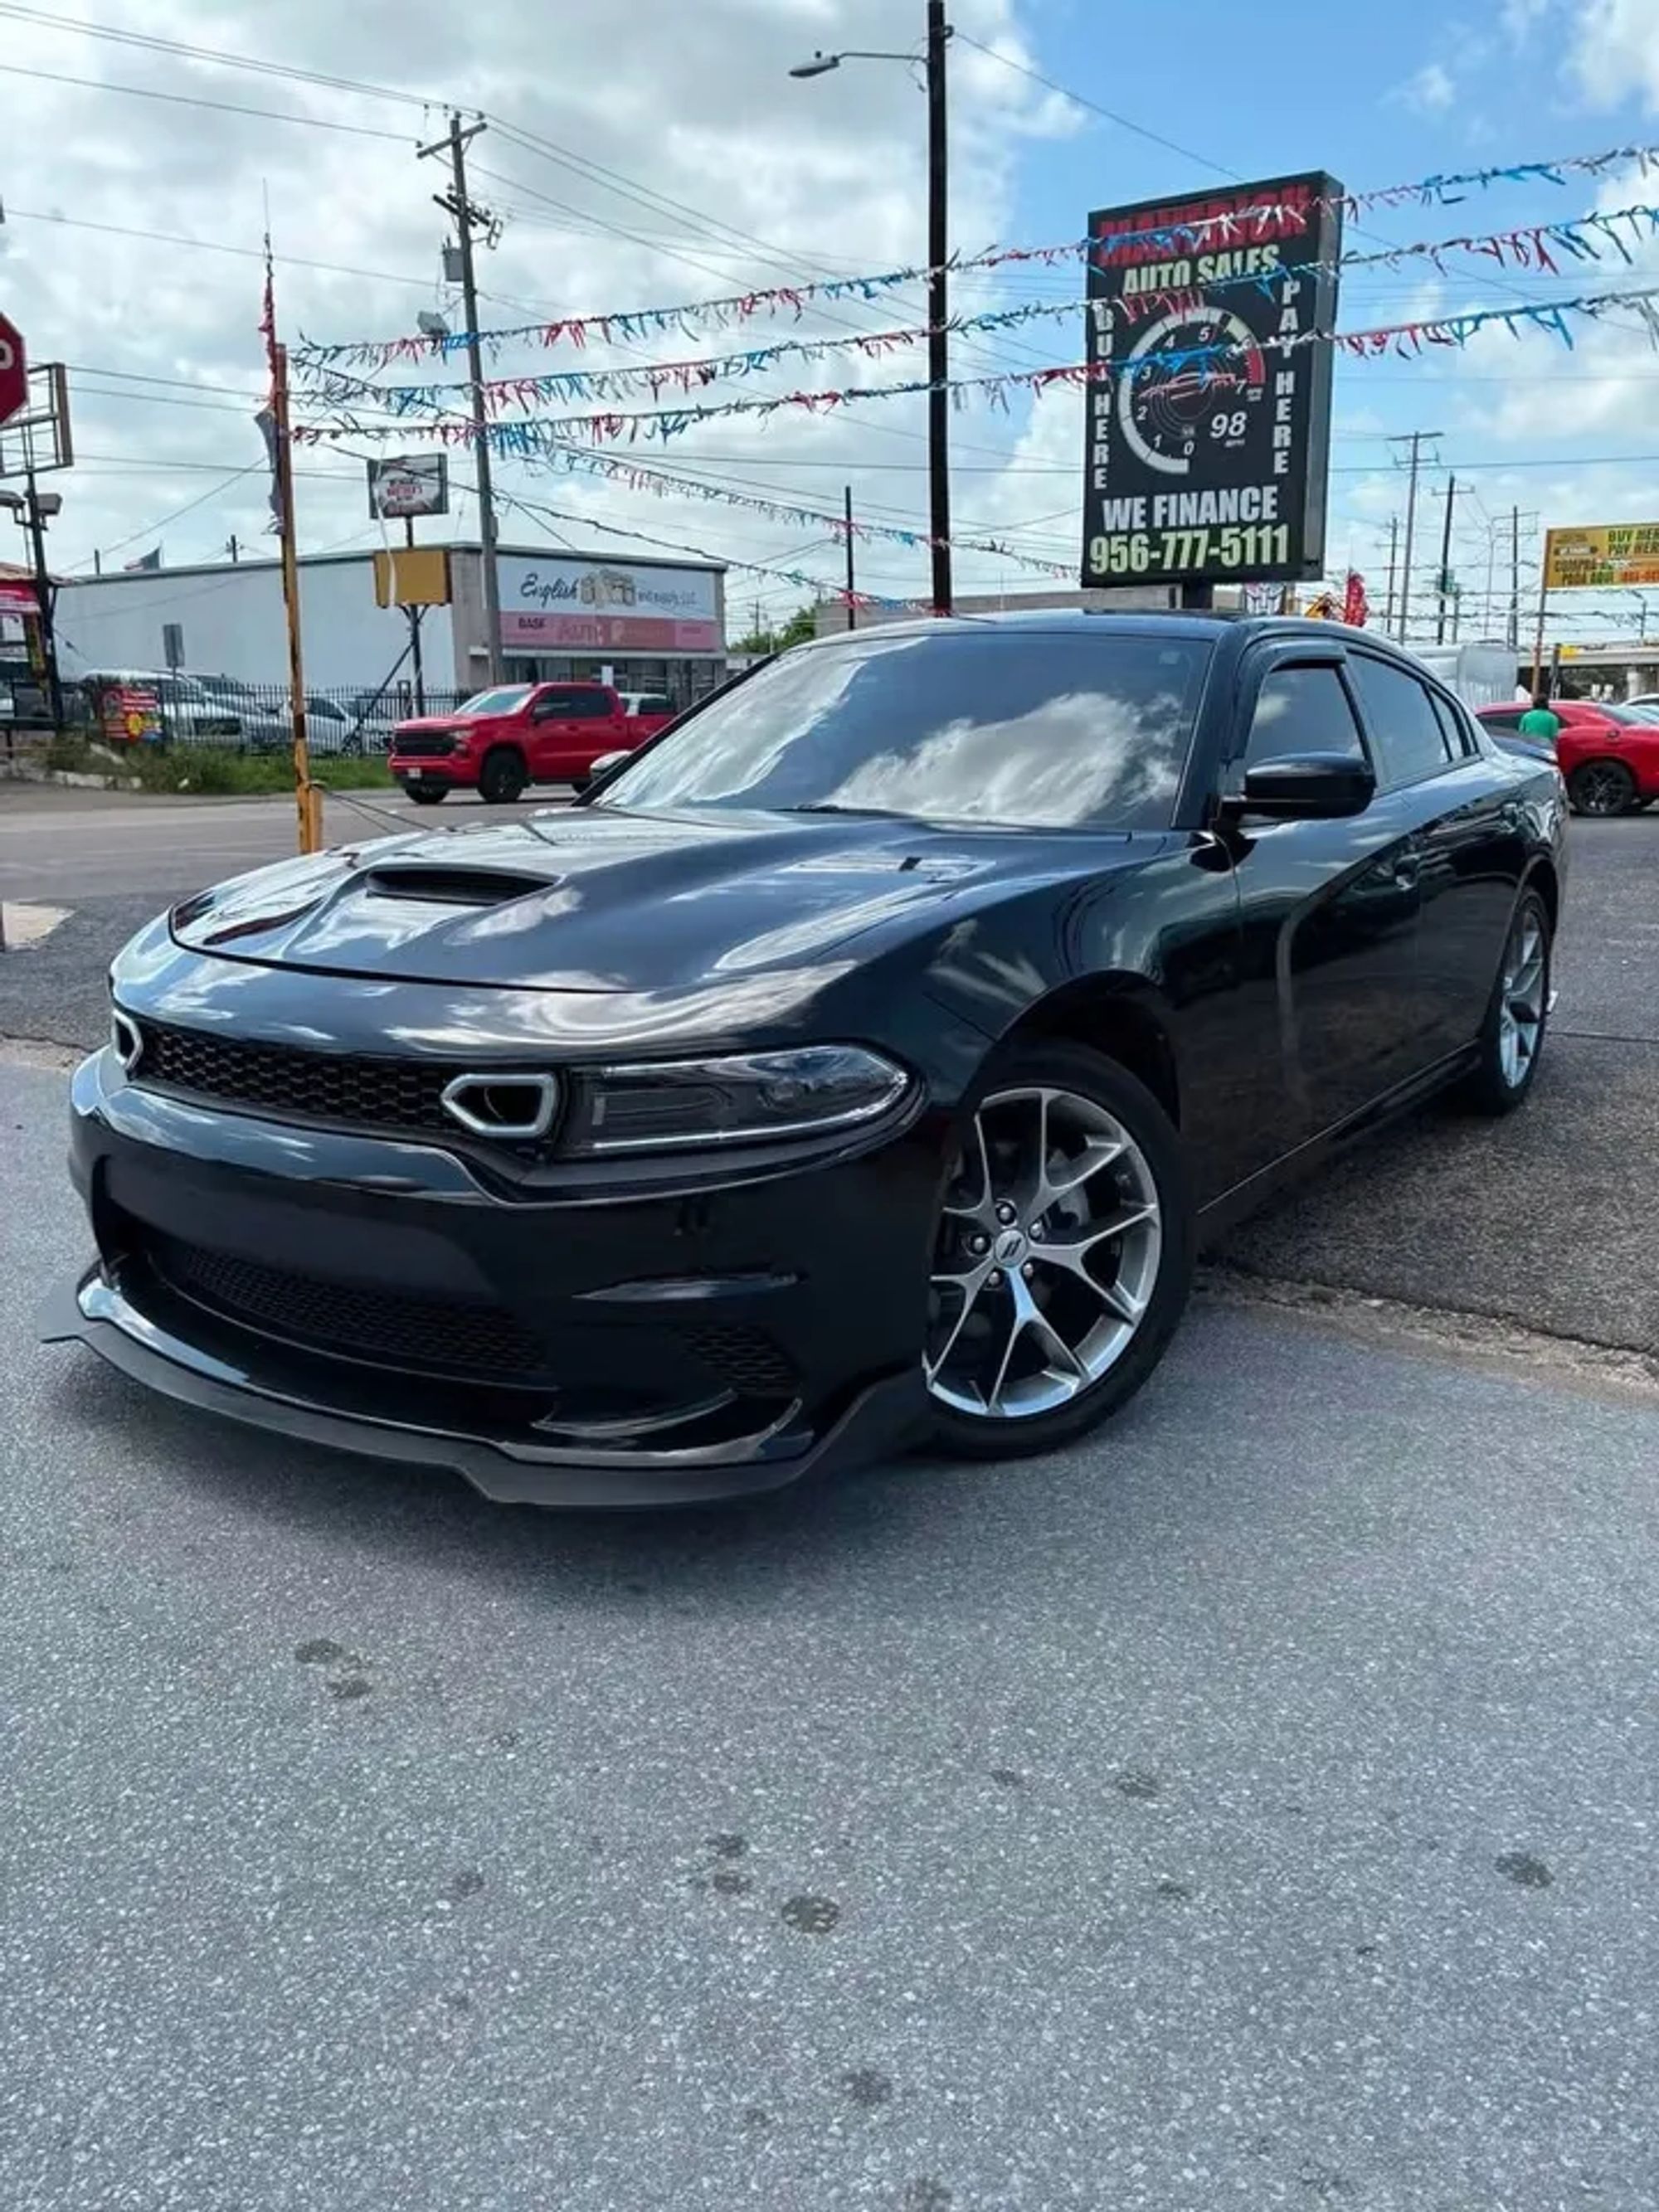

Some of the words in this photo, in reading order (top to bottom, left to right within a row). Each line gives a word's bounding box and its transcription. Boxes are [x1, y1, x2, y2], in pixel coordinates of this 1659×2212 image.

[1122, 260, 1191, 294] AUTO
[1197, 244, 1280, 284] SALES
[1198, 326, 1211, 342] 5
[1279, 281, 1301, 358] PAY
[1165, 334, 1175, 348] 4
[1141, 366, 1152, 380] 3
[1236, 379, 1248, 395] 7
[1136, 405, 1148, 421] 2
[1209, 411, 1248, 439] 98
[1272, 371, 1295, 474] HERE
[1094, 393, 1110, 489] HERE
[1184, 440, 1194, 455] 0
[1102, 498, 1146, 532] WE
[1153, 486, 1278, 528] FINANCE
[1089, 523, 1288, 575] 956-777-5111
[520, 573, 579, 608] English
